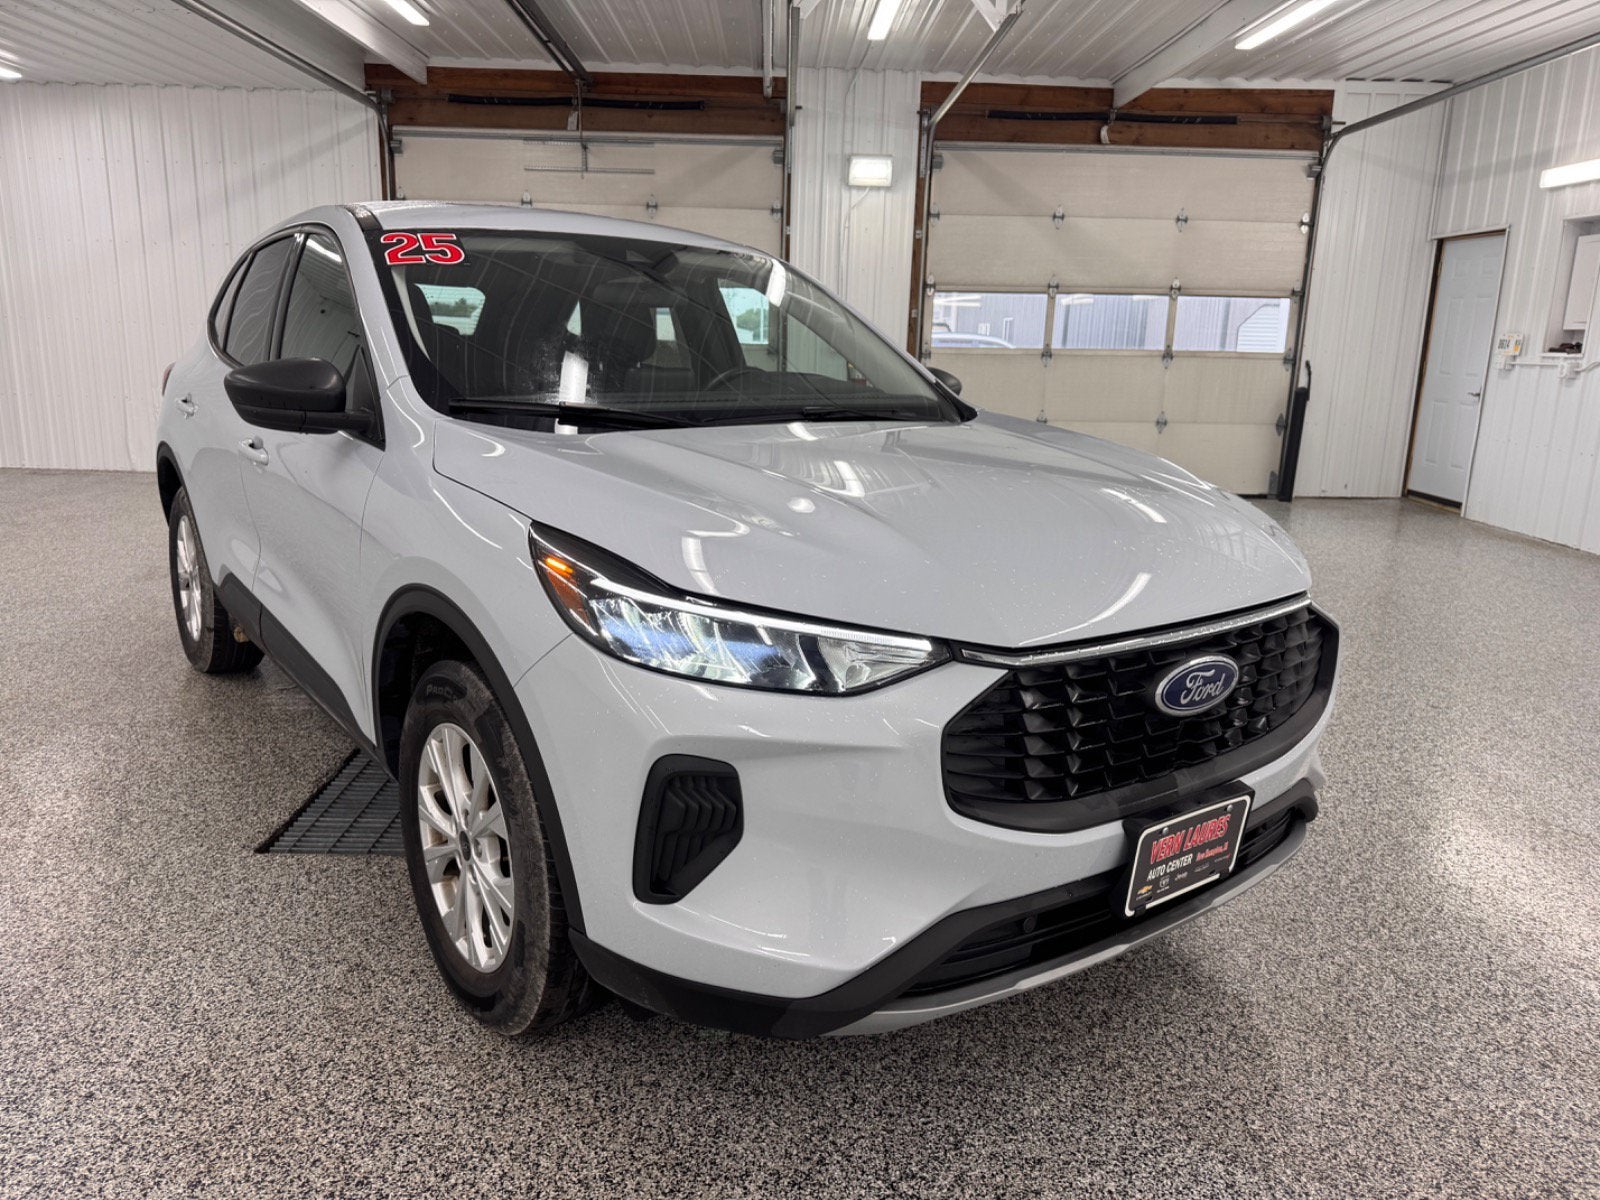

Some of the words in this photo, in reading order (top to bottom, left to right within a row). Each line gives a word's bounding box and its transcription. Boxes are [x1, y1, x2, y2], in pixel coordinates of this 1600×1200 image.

[380, 232, 465, 265] 25
[1181, 669, 1225, 705] Ford
[1150, 829, 1186, 864] VERN
[1183, 813, 1232, 851] LAURES
[1146, 864, 1166, 881] AUTO
[1166, 853, 1193, 873] CENTER
